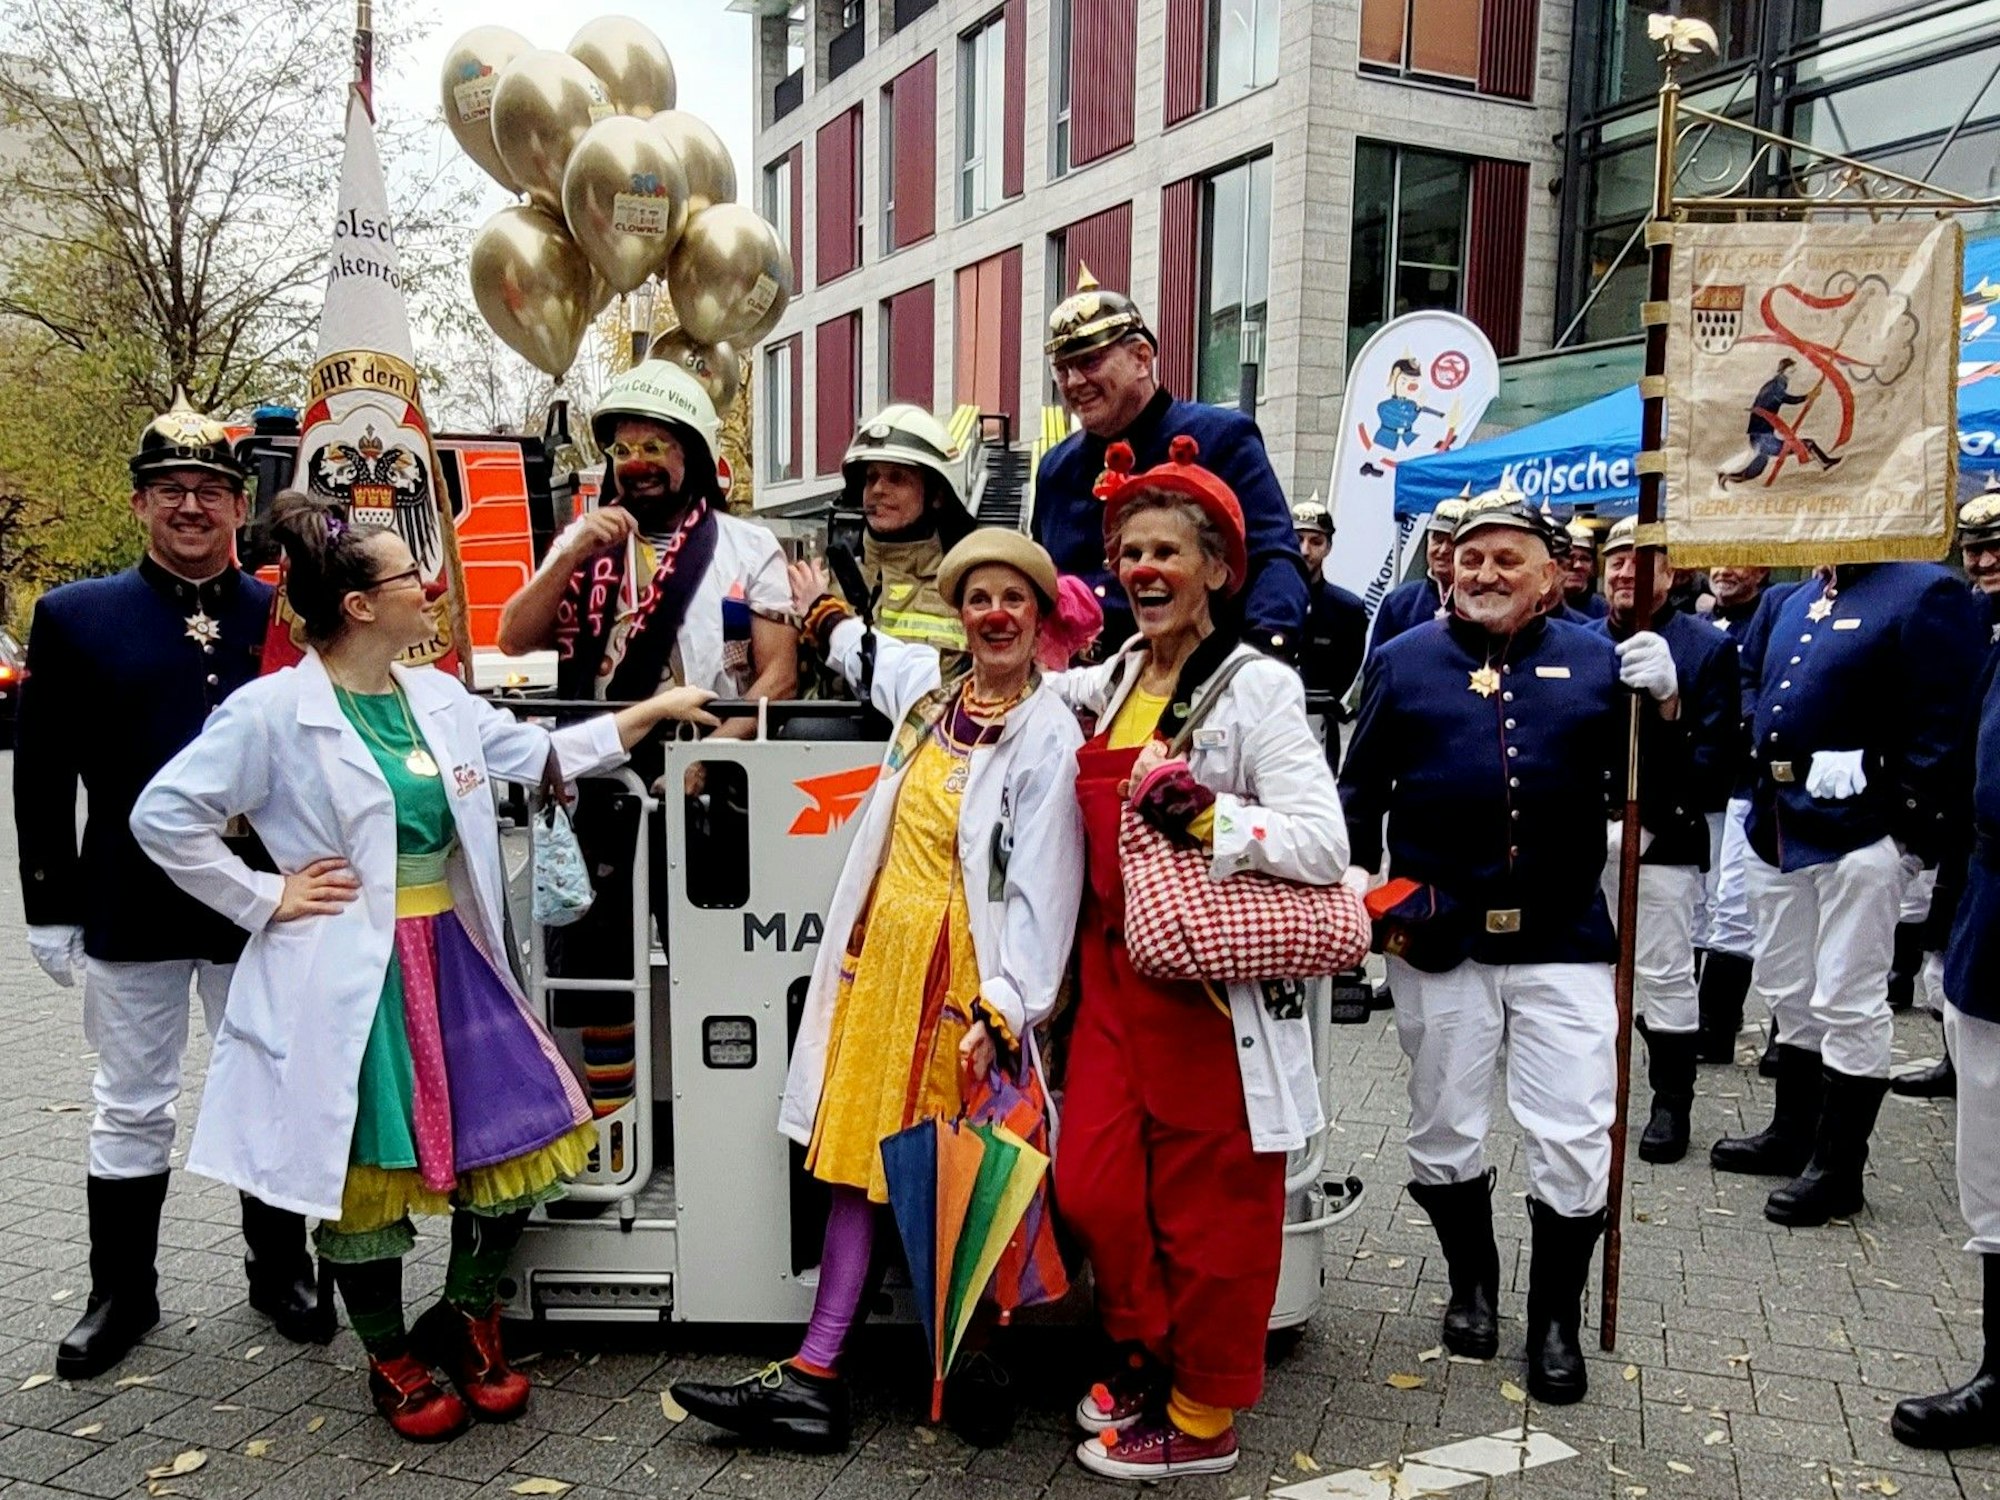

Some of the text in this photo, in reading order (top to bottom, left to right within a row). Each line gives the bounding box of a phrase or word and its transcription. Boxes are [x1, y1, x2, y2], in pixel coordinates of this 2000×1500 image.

[362, 362, 410, 398] dem
[668, 389, 698, 416] Vieira
[1499, 451, 1630, 497] Kölsche
[588, 557, 620, 637] der
[743, 912, 825, 952] MA
